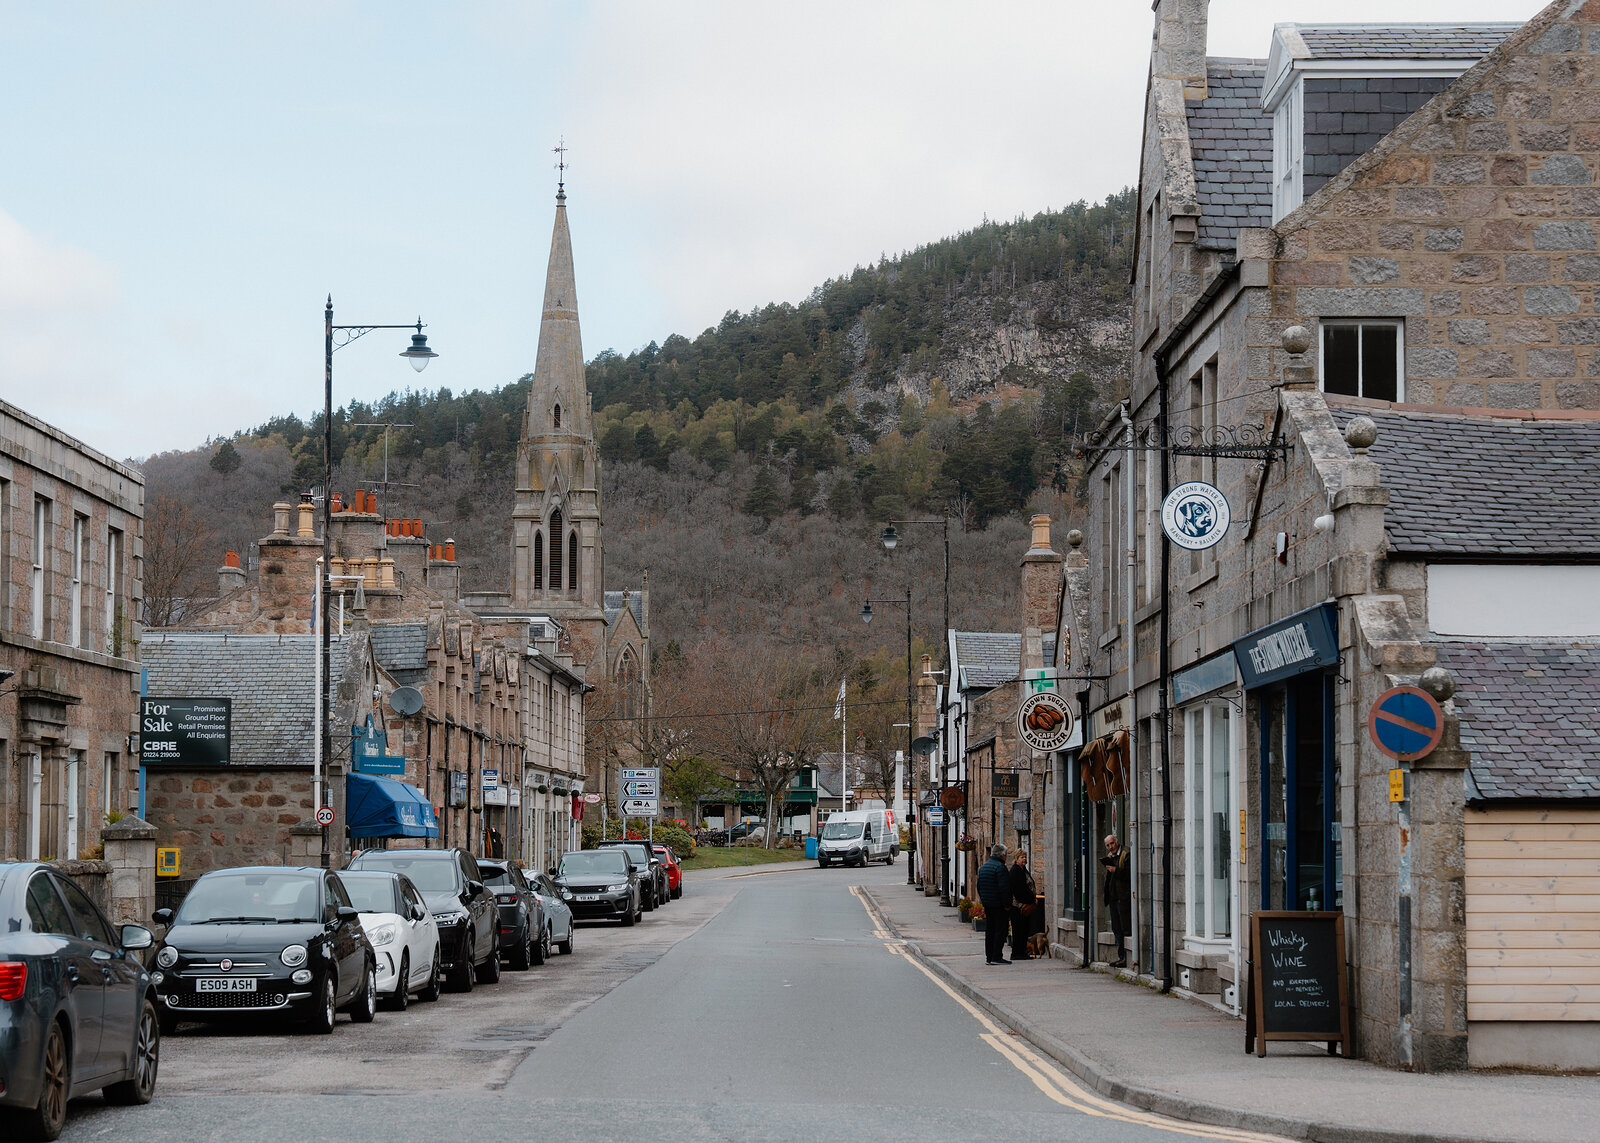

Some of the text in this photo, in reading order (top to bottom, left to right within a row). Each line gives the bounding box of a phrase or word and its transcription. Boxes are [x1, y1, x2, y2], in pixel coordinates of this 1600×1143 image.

[1168, 496, 1177, 507] THE
[1176, 486, 1198, 497] STRONG
[1200, 486, 1218, 500] WATER
[1170, 528, 1222, 546] BANCHORY BALLATER
[1248, 647, 1267, 674] THE
[144, 701, 170, 716] For
[1024, 695, 1067, 714] BROWN SUGAR
[144, 718, 173, 732] Sale
[143, 741, 177, 751] CBRE
[1026, 732, 1068, 748] BALLATER
[1268, 930, 1308, 952] Whisky
[1271, 952, 1307, 968] WINE
[200, 980, 252, 990] ES09 ASH
